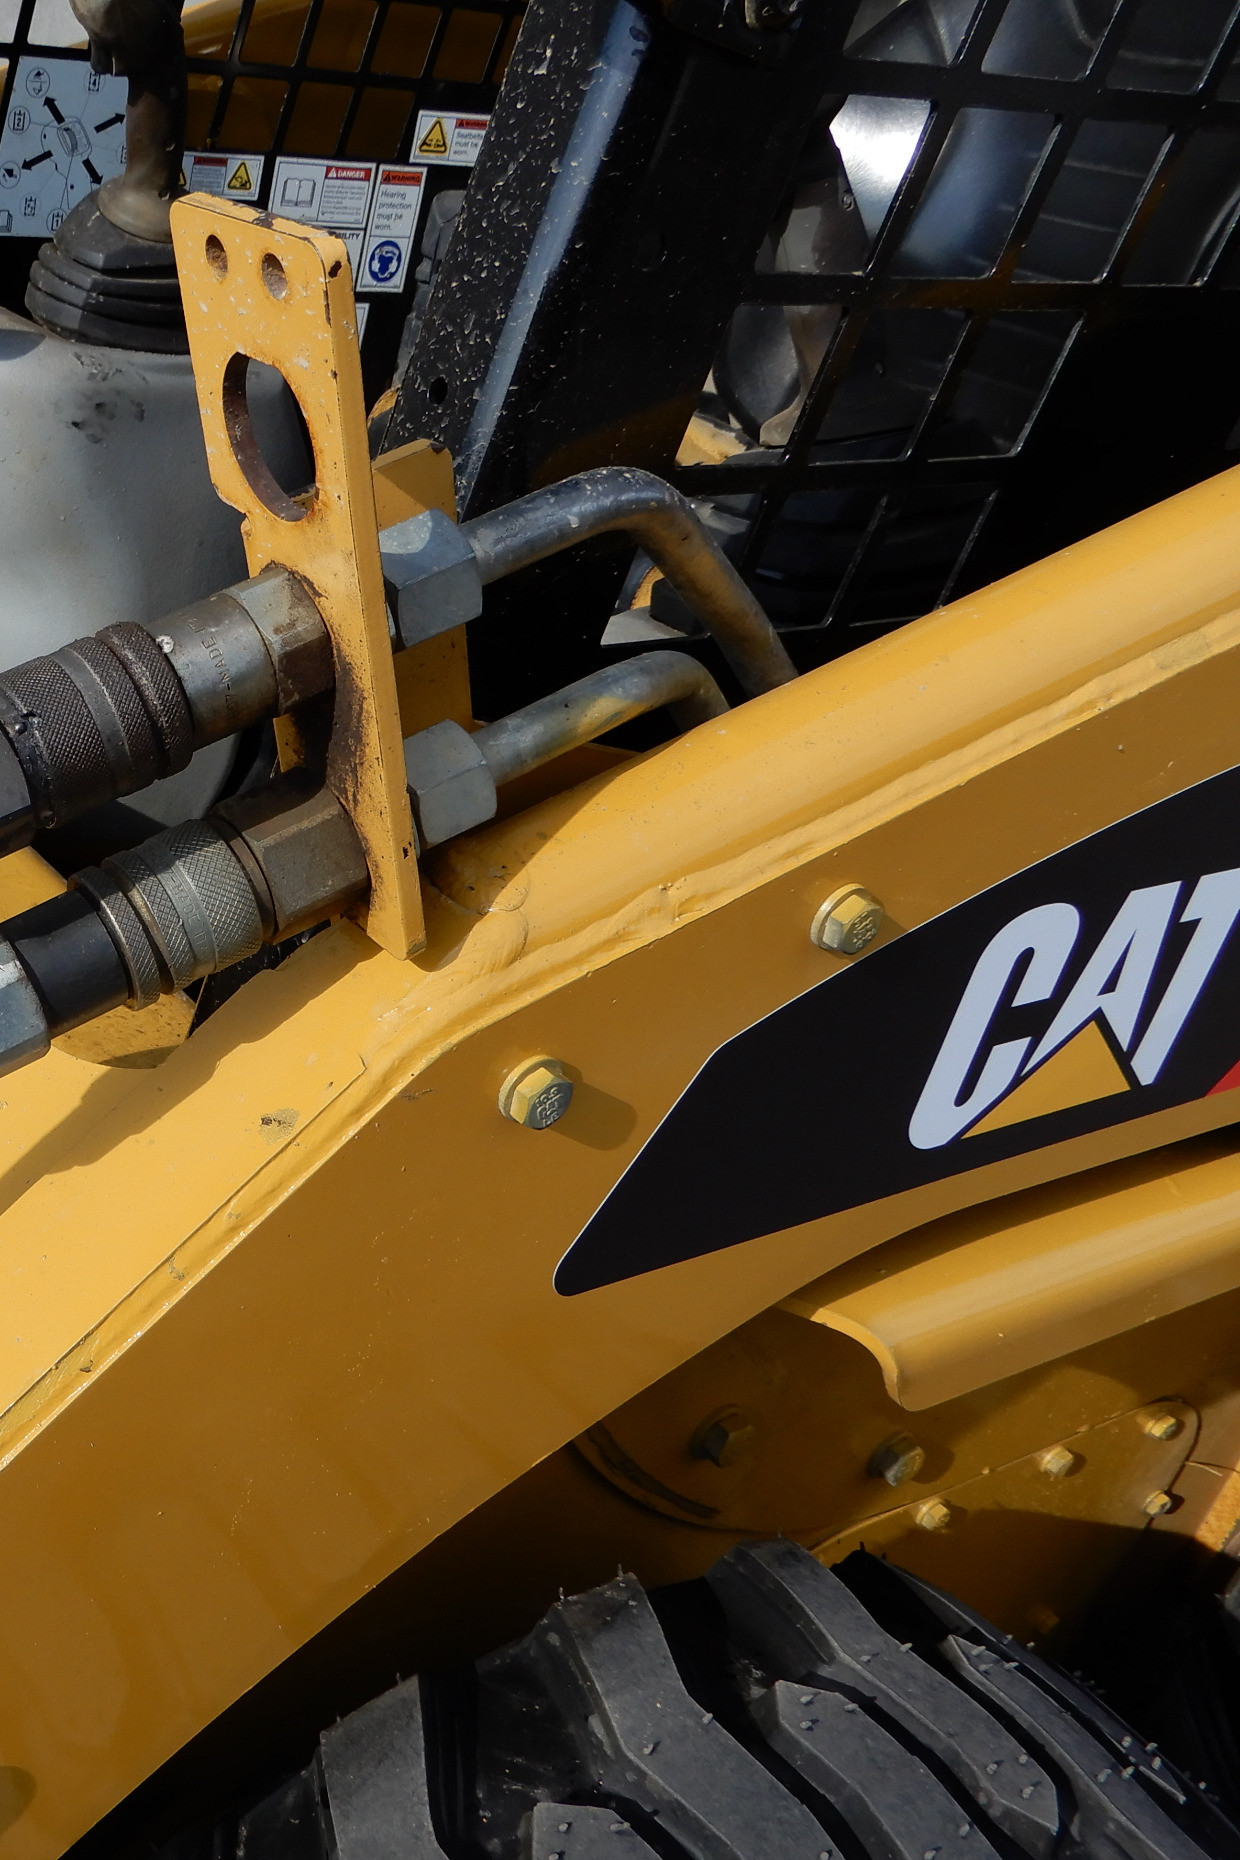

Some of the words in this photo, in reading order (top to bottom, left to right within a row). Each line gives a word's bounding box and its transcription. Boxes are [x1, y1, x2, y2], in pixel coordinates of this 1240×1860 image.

[337, 170, 366, 179] DANGER
[390, 174, 420, 183] WARNING
[380, 190, 407, 200] Hearing
[378, 201, 412, 211] protection
[376, 212, 392, 221] must
[393, 213, 403, 221] be
[907, 867, 1240, 1151] CAT
